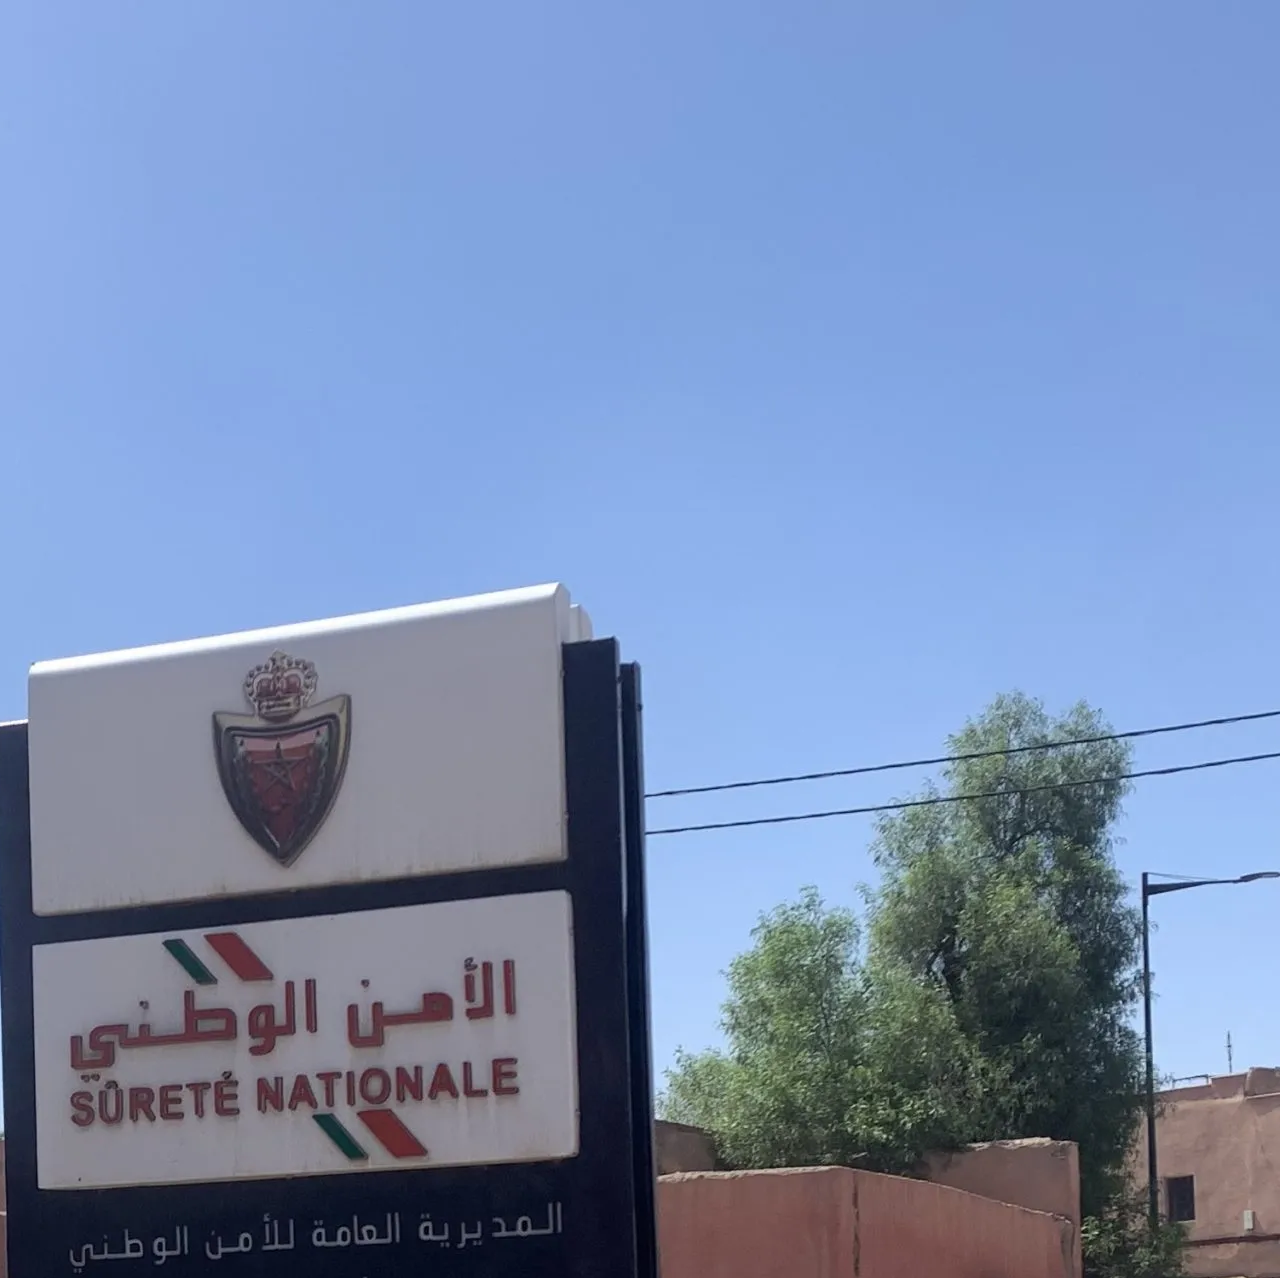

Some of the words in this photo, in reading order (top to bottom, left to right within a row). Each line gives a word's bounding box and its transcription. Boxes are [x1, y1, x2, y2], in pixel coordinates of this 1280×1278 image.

[346, 956, 517, 1050] الأمن
[69, 976, 318, 1084] الوطني
[69, 1070, 241, 1128] SÛRETÉ
[256, 1057, 520, 1115] NATIONALE
[68, 1224, 190, 1274] الوطني
[205, 1213, 295, 1260] للأمن
[311, 1212, 400, 1247] العامة
[418, 1201, 563, 1249] المديرية
